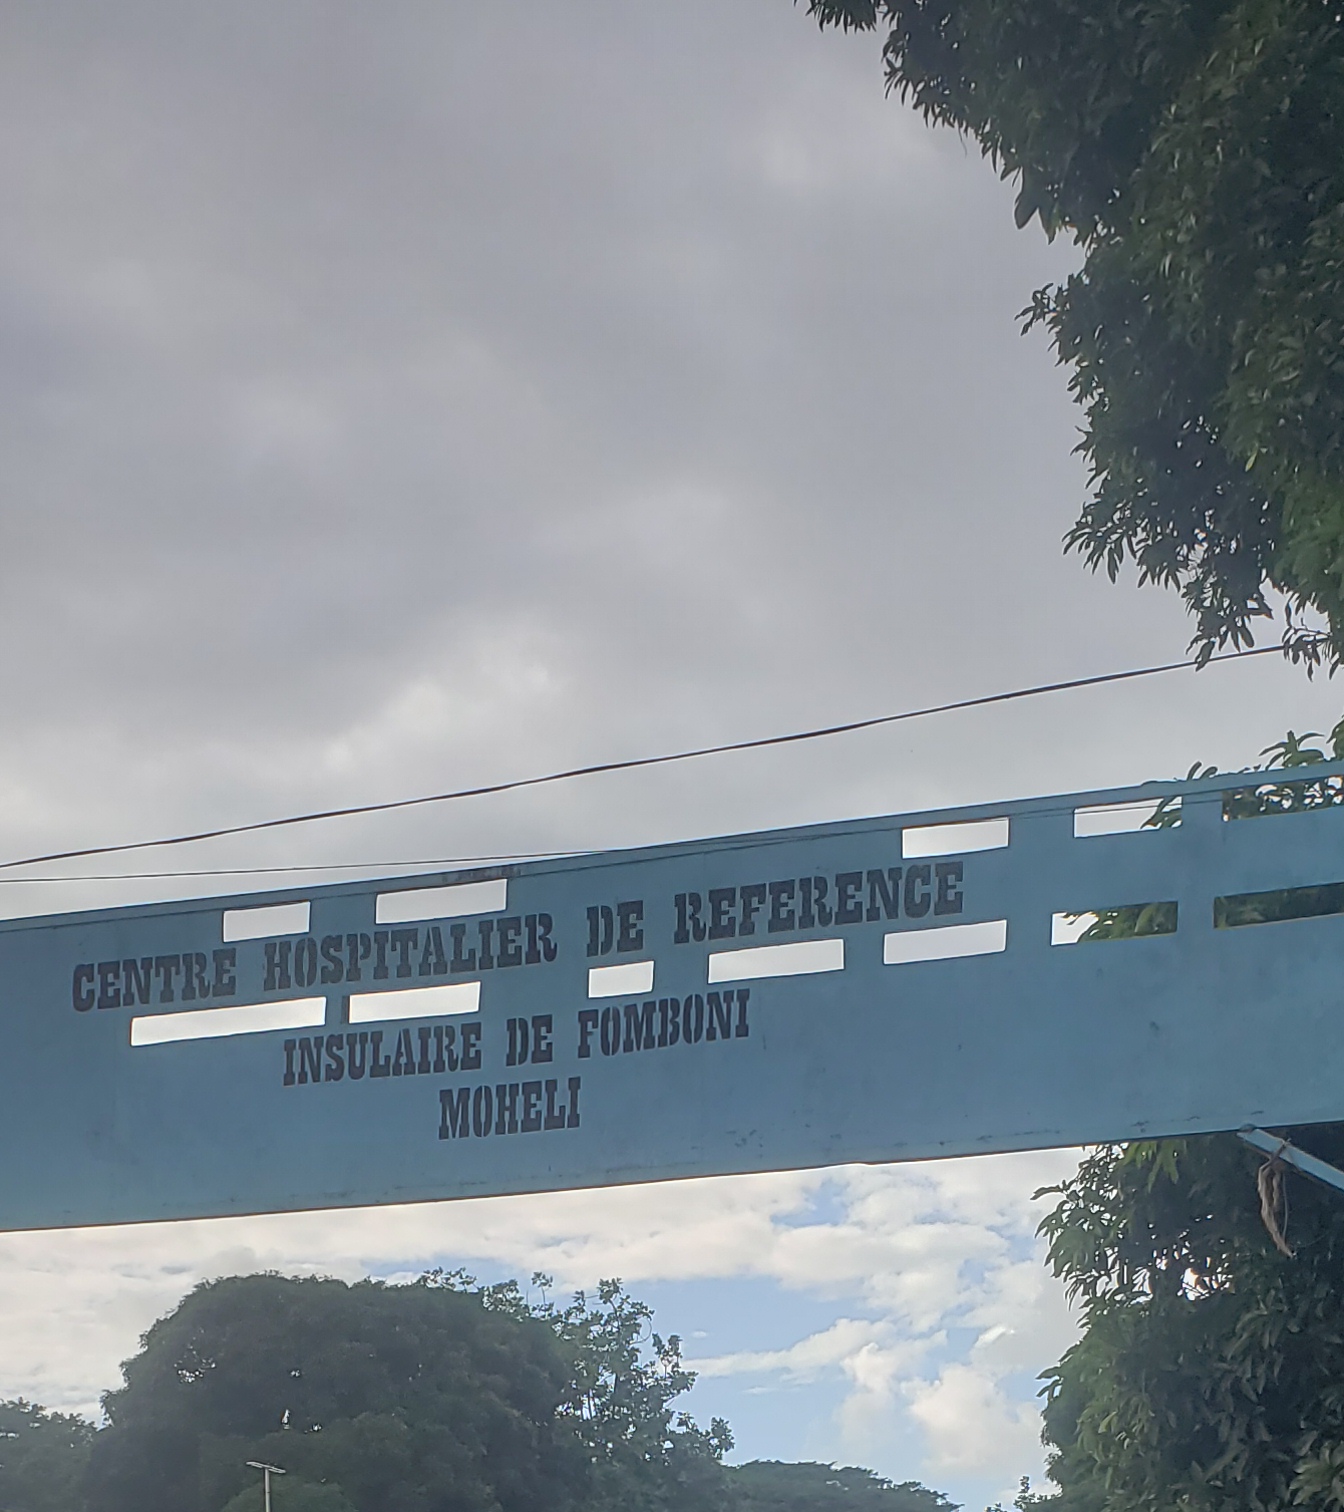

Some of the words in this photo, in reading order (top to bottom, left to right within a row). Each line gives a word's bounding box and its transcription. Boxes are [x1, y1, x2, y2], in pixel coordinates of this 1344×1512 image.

[71, 946, 237, 1014] CENTRE
[263, 914, 558, 993] HOSPITALIER
[586, 899, 644, 957] DE
[673, 861, 965, 945] REFERENCE
[282, 1021, 482, 1086] INSULAIRE
[505, 1016, 553, 1068] DE
[577, 989, 750, 1059] FOMBONI
[438, 1076, 582, 1141] MOHELI
